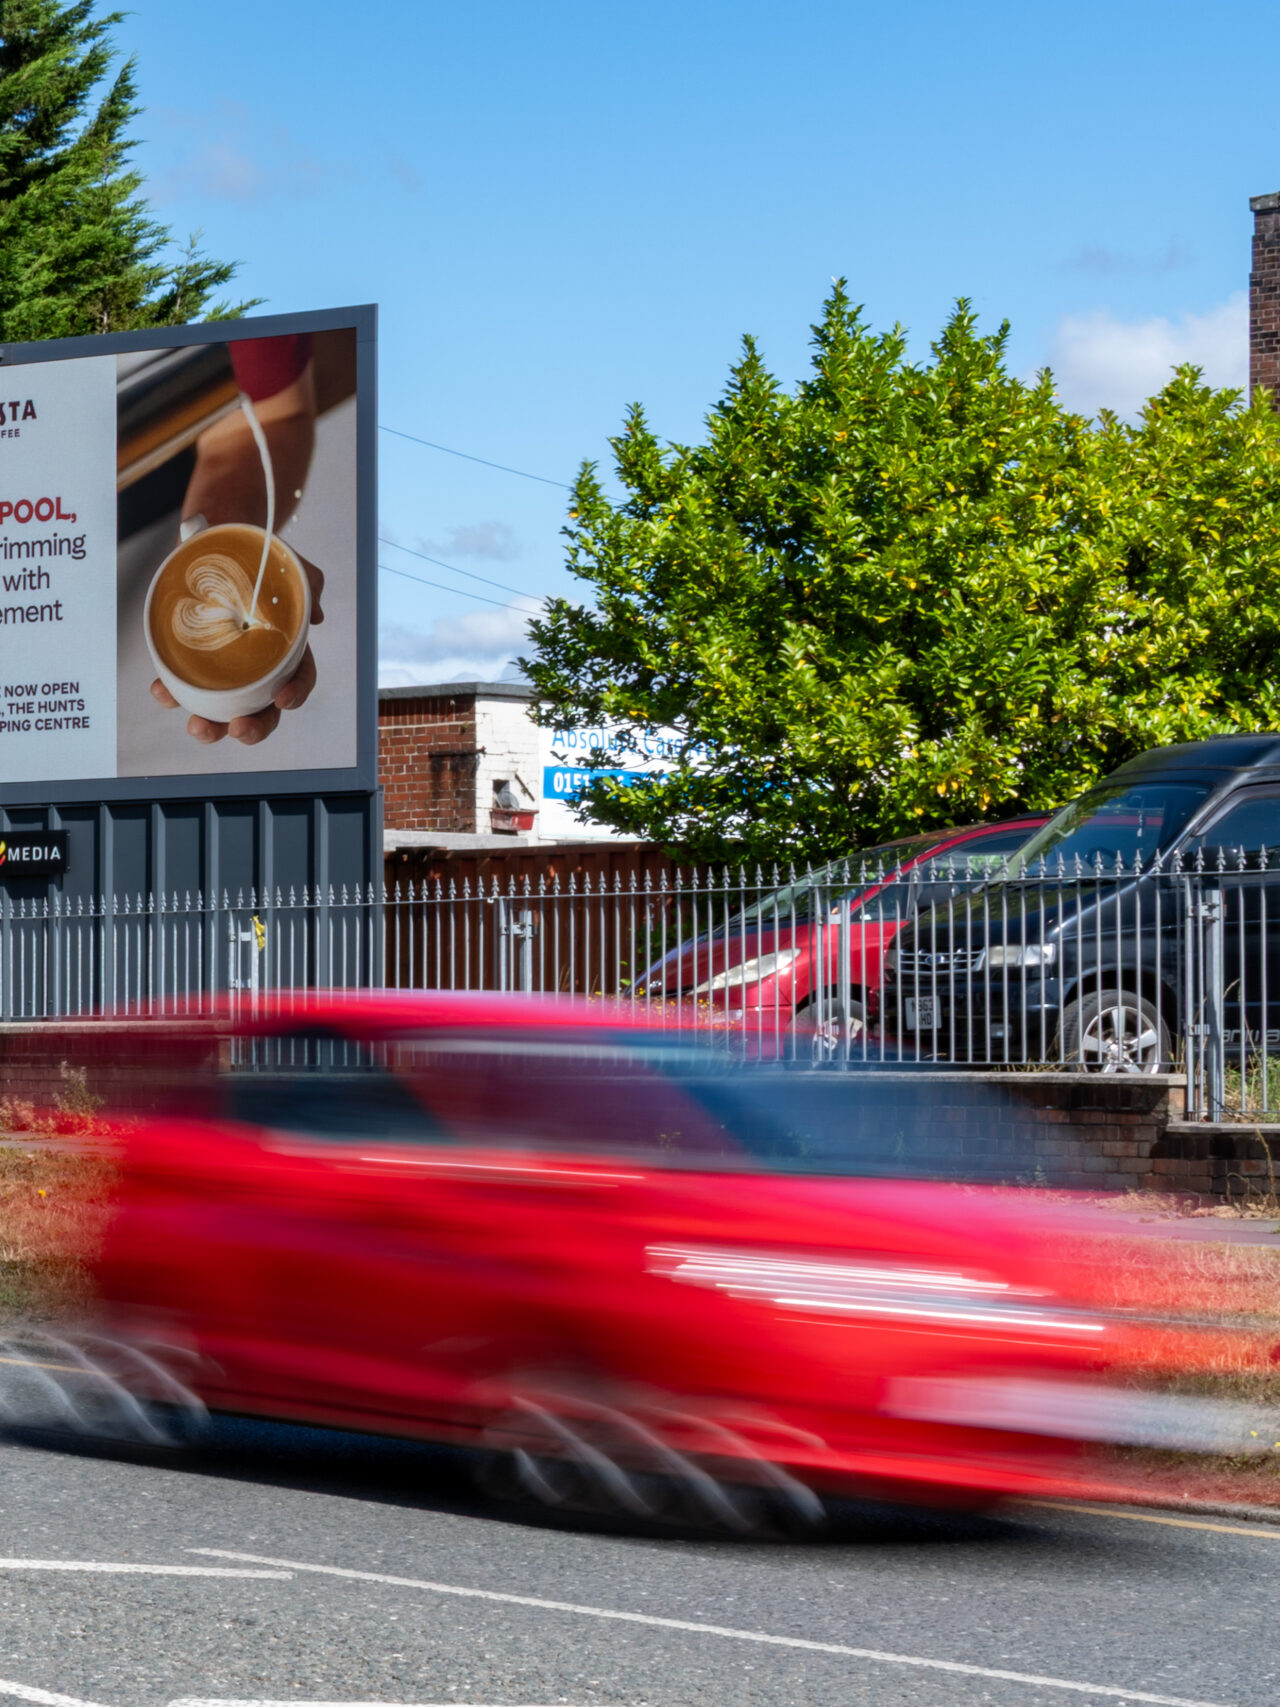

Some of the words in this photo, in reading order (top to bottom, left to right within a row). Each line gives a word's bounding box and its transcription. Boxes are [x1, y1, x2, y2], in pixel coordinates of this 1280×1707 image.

[2, 564, 50, 592] with
[4, 683, 38, 698] NOW
[40, 681, 80, 696] OPEN
[6, 701, 35, 715] THE
[37, 698, 86, 714] HUNTS
[34, 715, 90, 731] CENTRE
[6, 845, 62, 862] MEDIA
